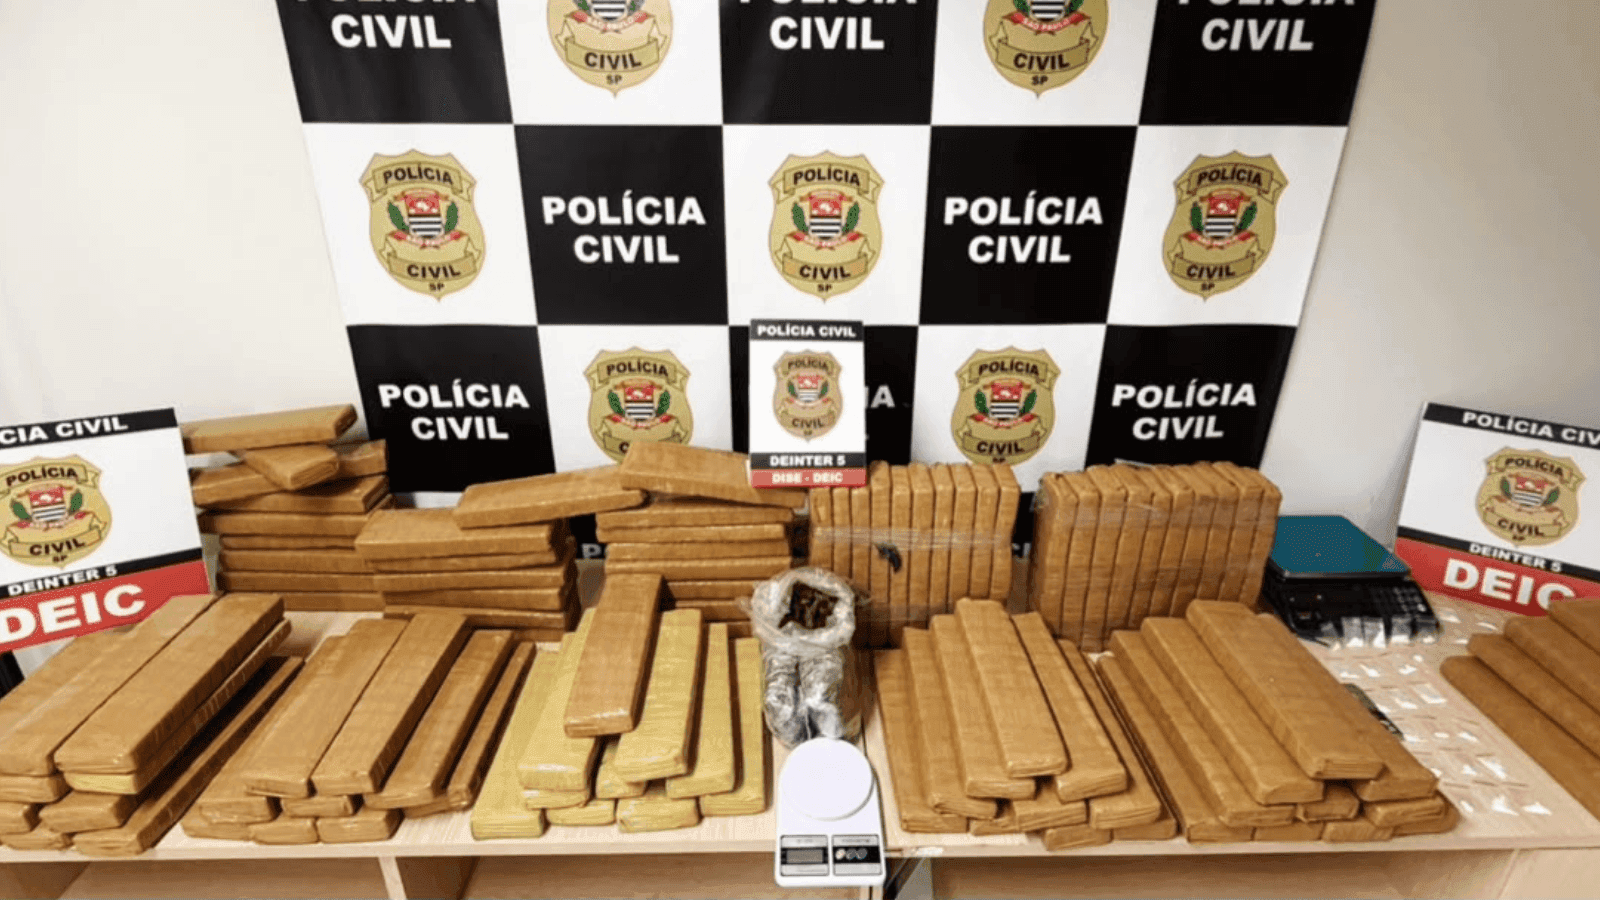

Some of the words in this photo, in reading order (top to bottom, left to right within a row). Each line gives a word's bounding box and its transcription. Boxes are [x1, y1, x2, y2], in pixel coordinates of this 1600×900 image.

[331, 14, 452, 49] CIVIL
[769, 16, 885, 50] CIVIL
[1202, 18, 1313, 51] CIVIL
[584, 52, 642, 70] CIVIL
[1013, 53, 1070, 71] CIVIL
[606, 74, 622, 85] SP
[1031, 75, 1048, 85] SP
[383, 163, 453, 185] POLÍCIA
[793, 163, 860, 186] POLÍCIA
[1197, 164, 1262, 186] POLÍCIA
[541, 190, 706, 226] POLÍCIA
[944, 190, 1103, 226] POLÍCIA
[573, 235, 680, 263] CIVIL
[968, 235, 1071, 264] CIVIL
[407, 264, 461, 279] CIVIL
[799, 264, 851, 280] CIVIL
[1186, 264, 1235, 279] CIVIL
[757, 323, 815, 337] POLÍCIA
[818, 325, 856, 338] CIVIL
[606, 358, 669, 377] POLÍCIA
[787, 357, 829, 370] POLÍCIA
[978, 358, 1039, 376] POLÍCIA
[378, 379, 530, 408] POLÍCIA
[1111, 379, 1256, 408] POLÍCIA
[55, 416, 128, 438] CIVIL
[411, 416, 509, 440] CIVIL
[791, 417, 825, 429] CIVIL
[1132, 415, 1223, 440] CIVIL
[1462, 410, 1554, 438] POLÍCIA
[977, 440, 1025, 456] CIVIL
[769, 454, 833, 468] DEINTER
[837, 455, 846, 467] 5
[1505, 457, 1564, 477] POLÍCIA
[6, 464, 78, 487] POLÍCIA
[812, 471, 844, 484] DEIC
[1497, 517, 1545, 537] CIVIL
[29, 537, 85, 557] CIVIL
[1469, 542, 1546, 569] DEINTER
[1551, 560, 1563, 573] 5
[7, 568, 100, 597] DEINTER
[104, 565, 118, 577] 5
[1443, 557, 1576, 611] DEIC
[0, 583, 146, 645] DEIC
